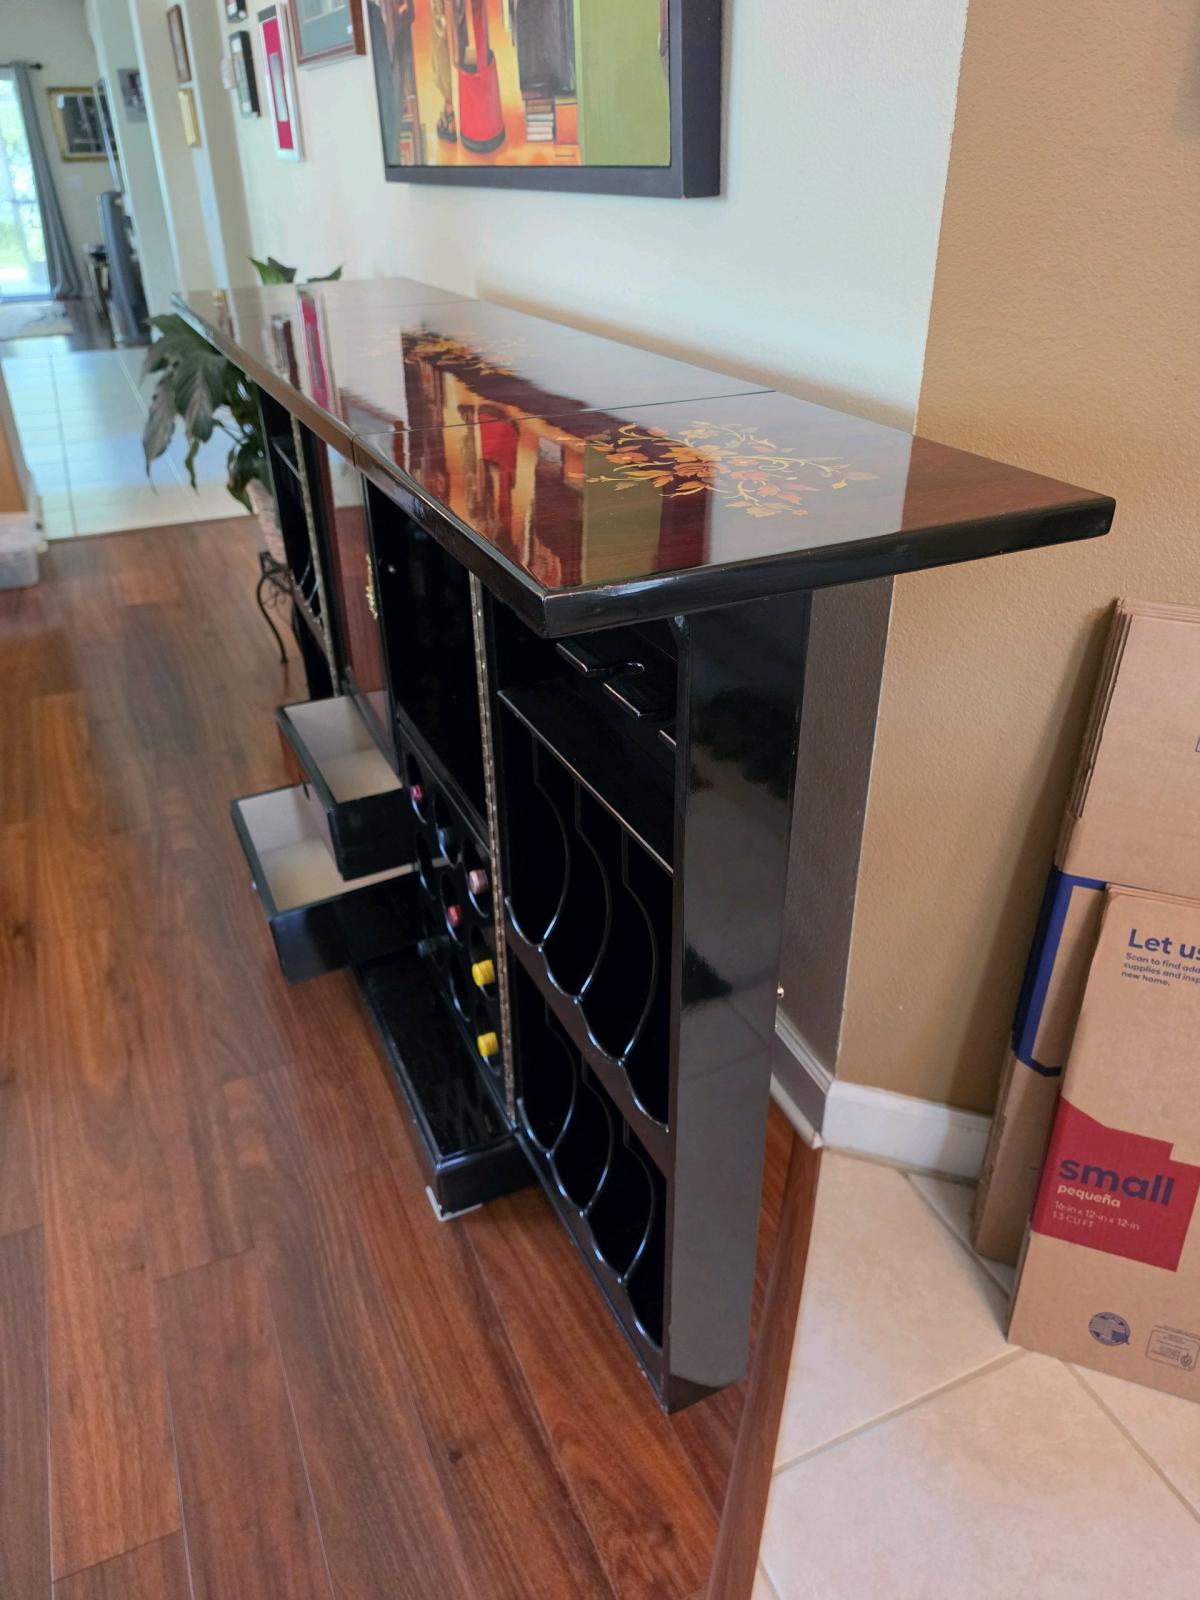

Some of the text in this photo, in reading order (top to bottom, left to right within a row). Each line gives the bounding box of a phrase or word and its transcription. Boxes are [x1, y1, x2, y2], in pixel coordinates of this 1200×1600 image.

[1128, 928, 1172, 954] Let
[1123, 962, 1160, 975] supplies
[1162, 970, 1181, 980] and
[1126, 952, 1148, 963] Scan
[1151, 958, 1161, 966] to
[1162, 960, 1181, 970] find
[1121, 971, 1170, 986] new home.
[1059, 1159, 1175, 1206] small
[1057, 1185, 1120, 1207] pequeña
[1066, 1215, 1080, 1225] CU
[1082, 1219, 1094, 1228] FT
[1086, 1209, 1108, 1222] 12-in
[1117, 1217, 1140, 1231] 12-in
